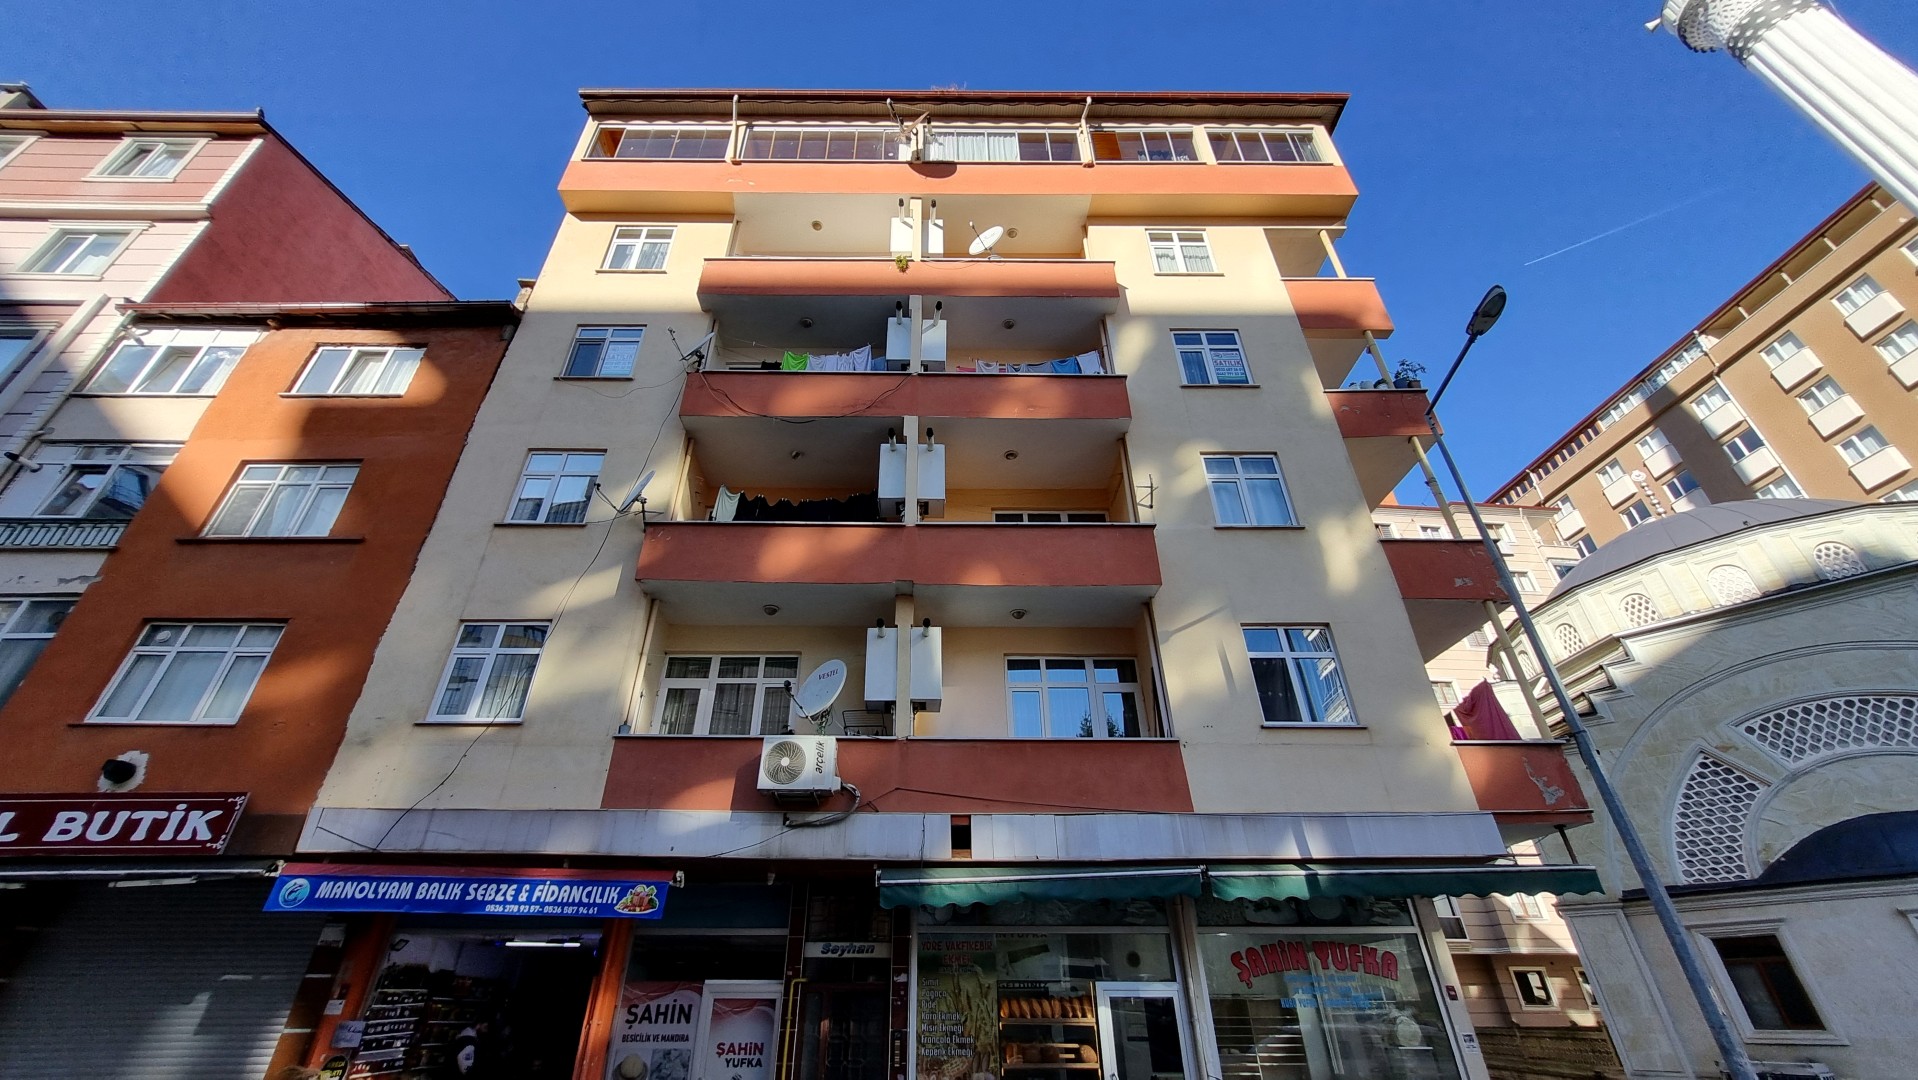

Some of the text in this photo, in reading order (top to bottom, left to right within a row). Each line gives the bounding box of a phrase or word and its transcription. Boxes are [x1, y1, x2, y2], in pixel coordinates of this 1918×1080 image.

[815, 740, 826, 774] arçelik
[42, 803, 223, 841] BUTİK
[314, 881, 621, 904] MANOLYAM BALIK SEBZE & FİDANCILIK
[485, 904, 503, 913] 0536
[504, 904, 518, 913] 378
[519, 905, 529, 914] 93
[543, 905, 561, 914] 0536
[563, 906, 577, 915] 587
[588, 906, 598, 915] 61
[820, 942, 876, 958] Seyhan
[1230, 940, 1399, 989] ŞAHİN YUFKA
[625, 998, 693, 1030] ŞAHİN
[652, 1033, 661, 1043] VE
[661, 1033, 690, 1043] MANDIRA
[716, 1041, 765, 1058] ŞAHİN
[725, 1058, 763, 1068] YUFKA
